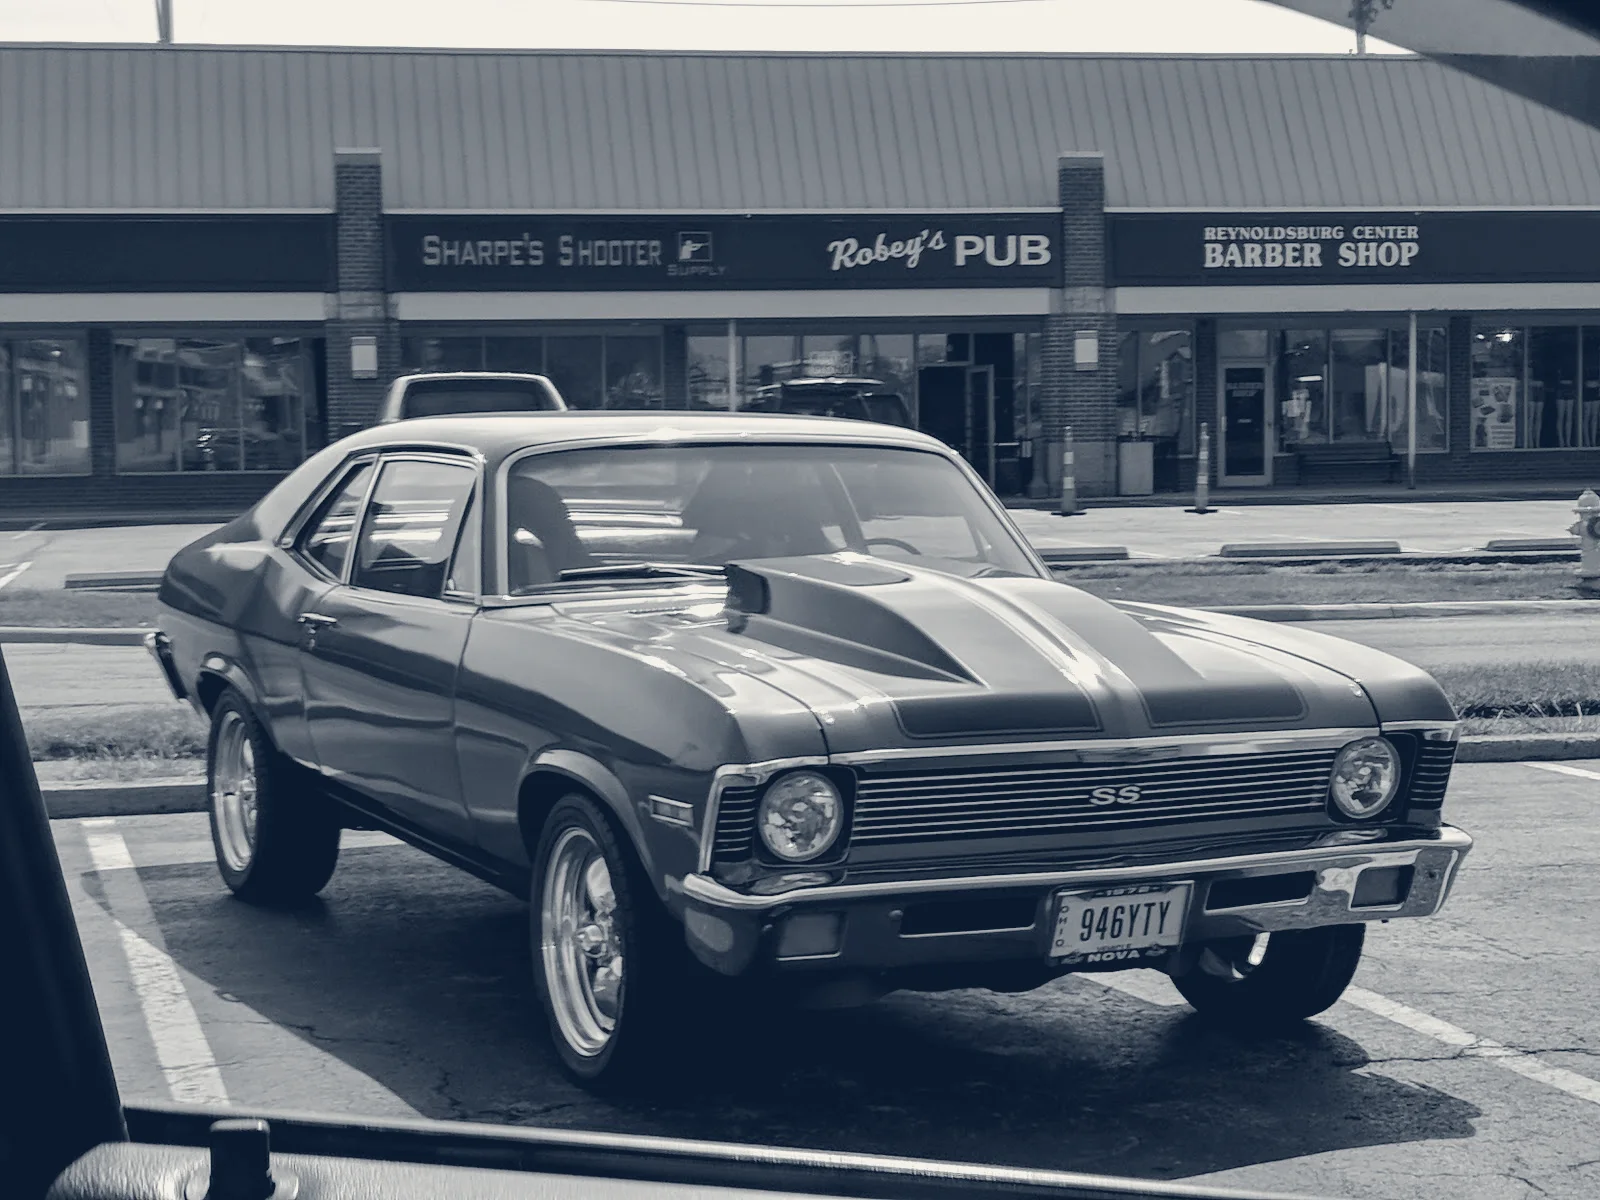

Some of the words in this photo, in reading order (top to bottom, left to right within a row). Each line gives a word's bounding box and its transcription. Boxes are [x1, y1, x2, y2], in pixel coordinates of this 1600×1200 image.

[1204, 226, 1345, 241] REYNOLDSBURG
[1352, 226, 1420, 240] CENTER
[559, 234, 663, 266] SHOOTER
[828, 229, 946, 270] Robey's
[955, 234, 1052, 267] PUB
[1203, 243, 1323, 268] BARBER
[1338, 242, 1420, 267] SHOP
[667, 264, 726, 276] SUPPLY
[1090, 785, 1141, 806] SS
[1056, 906, 1069, 946] OHIO
[1080, 901, 1171, 942] 946YTY
[1088, 951, 1140, 964] NOVA
